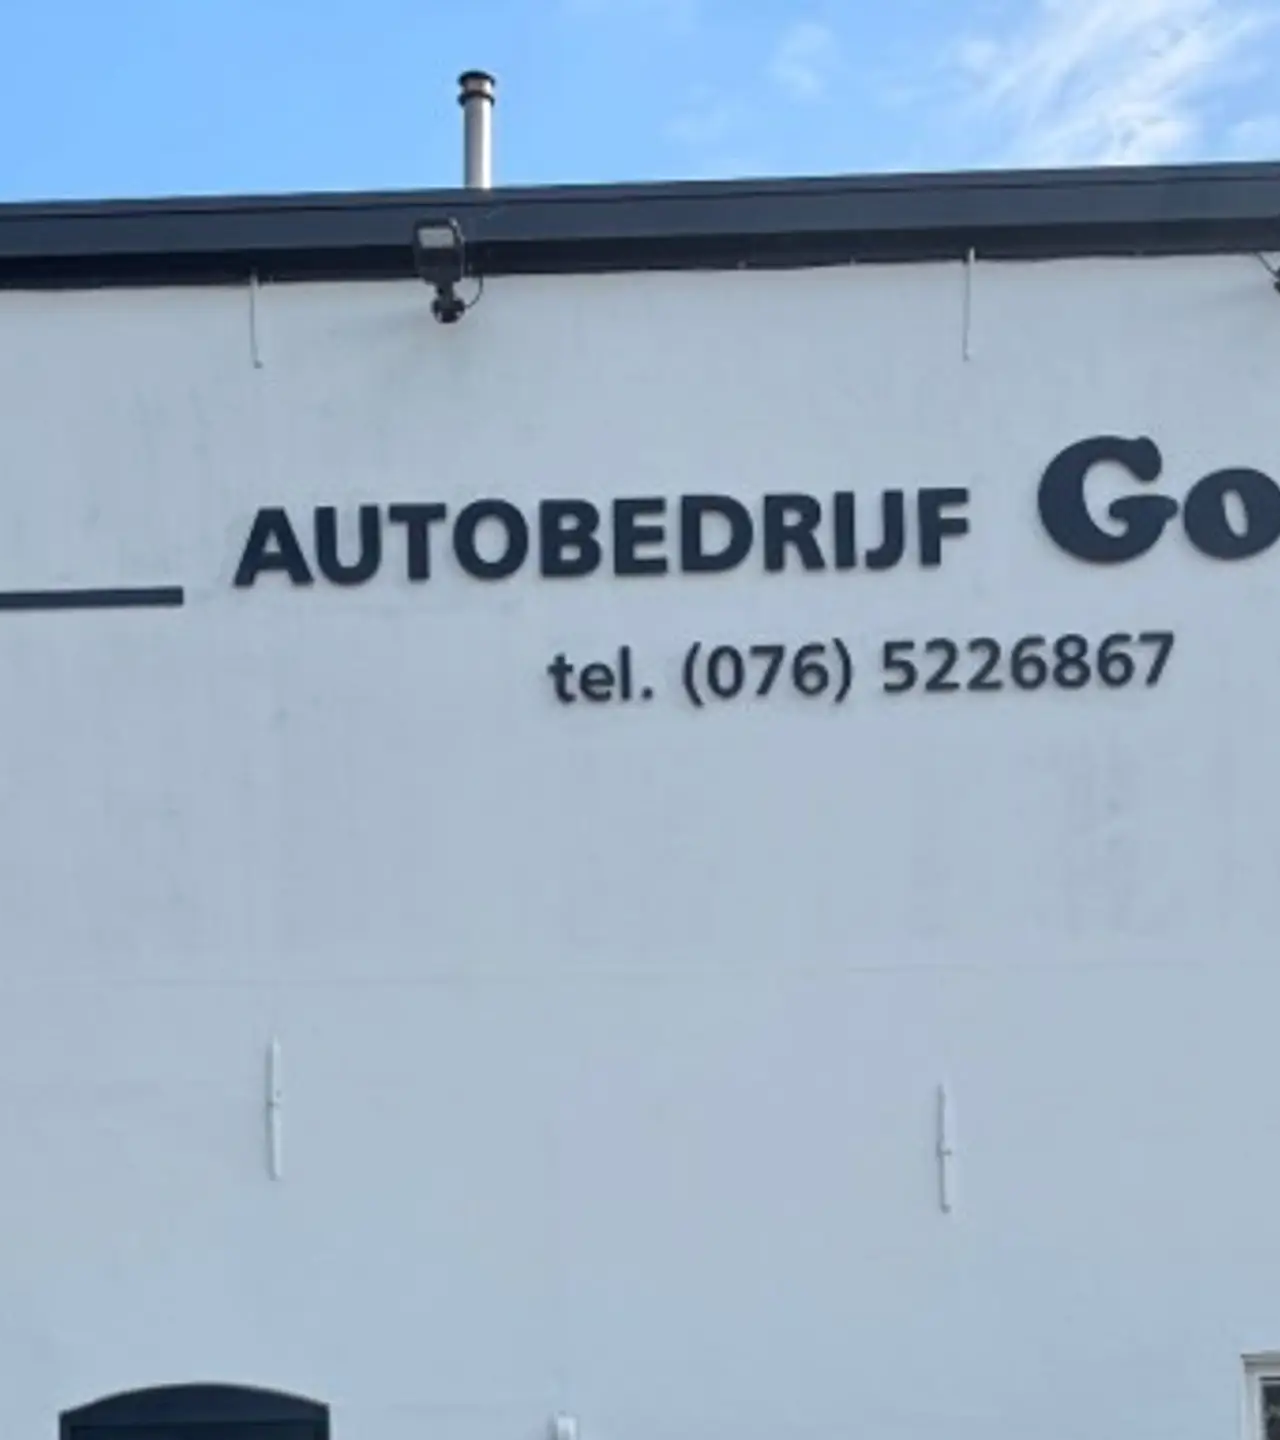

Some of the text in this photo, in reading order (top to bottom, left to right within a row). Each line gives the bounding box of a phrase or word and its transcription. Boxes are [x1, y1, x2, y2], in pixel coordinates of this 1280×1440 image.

[234, 487, 970, 588] AUTOBEDRIJF
[548, 631, 1176, 707] tel. (076) 5226867
